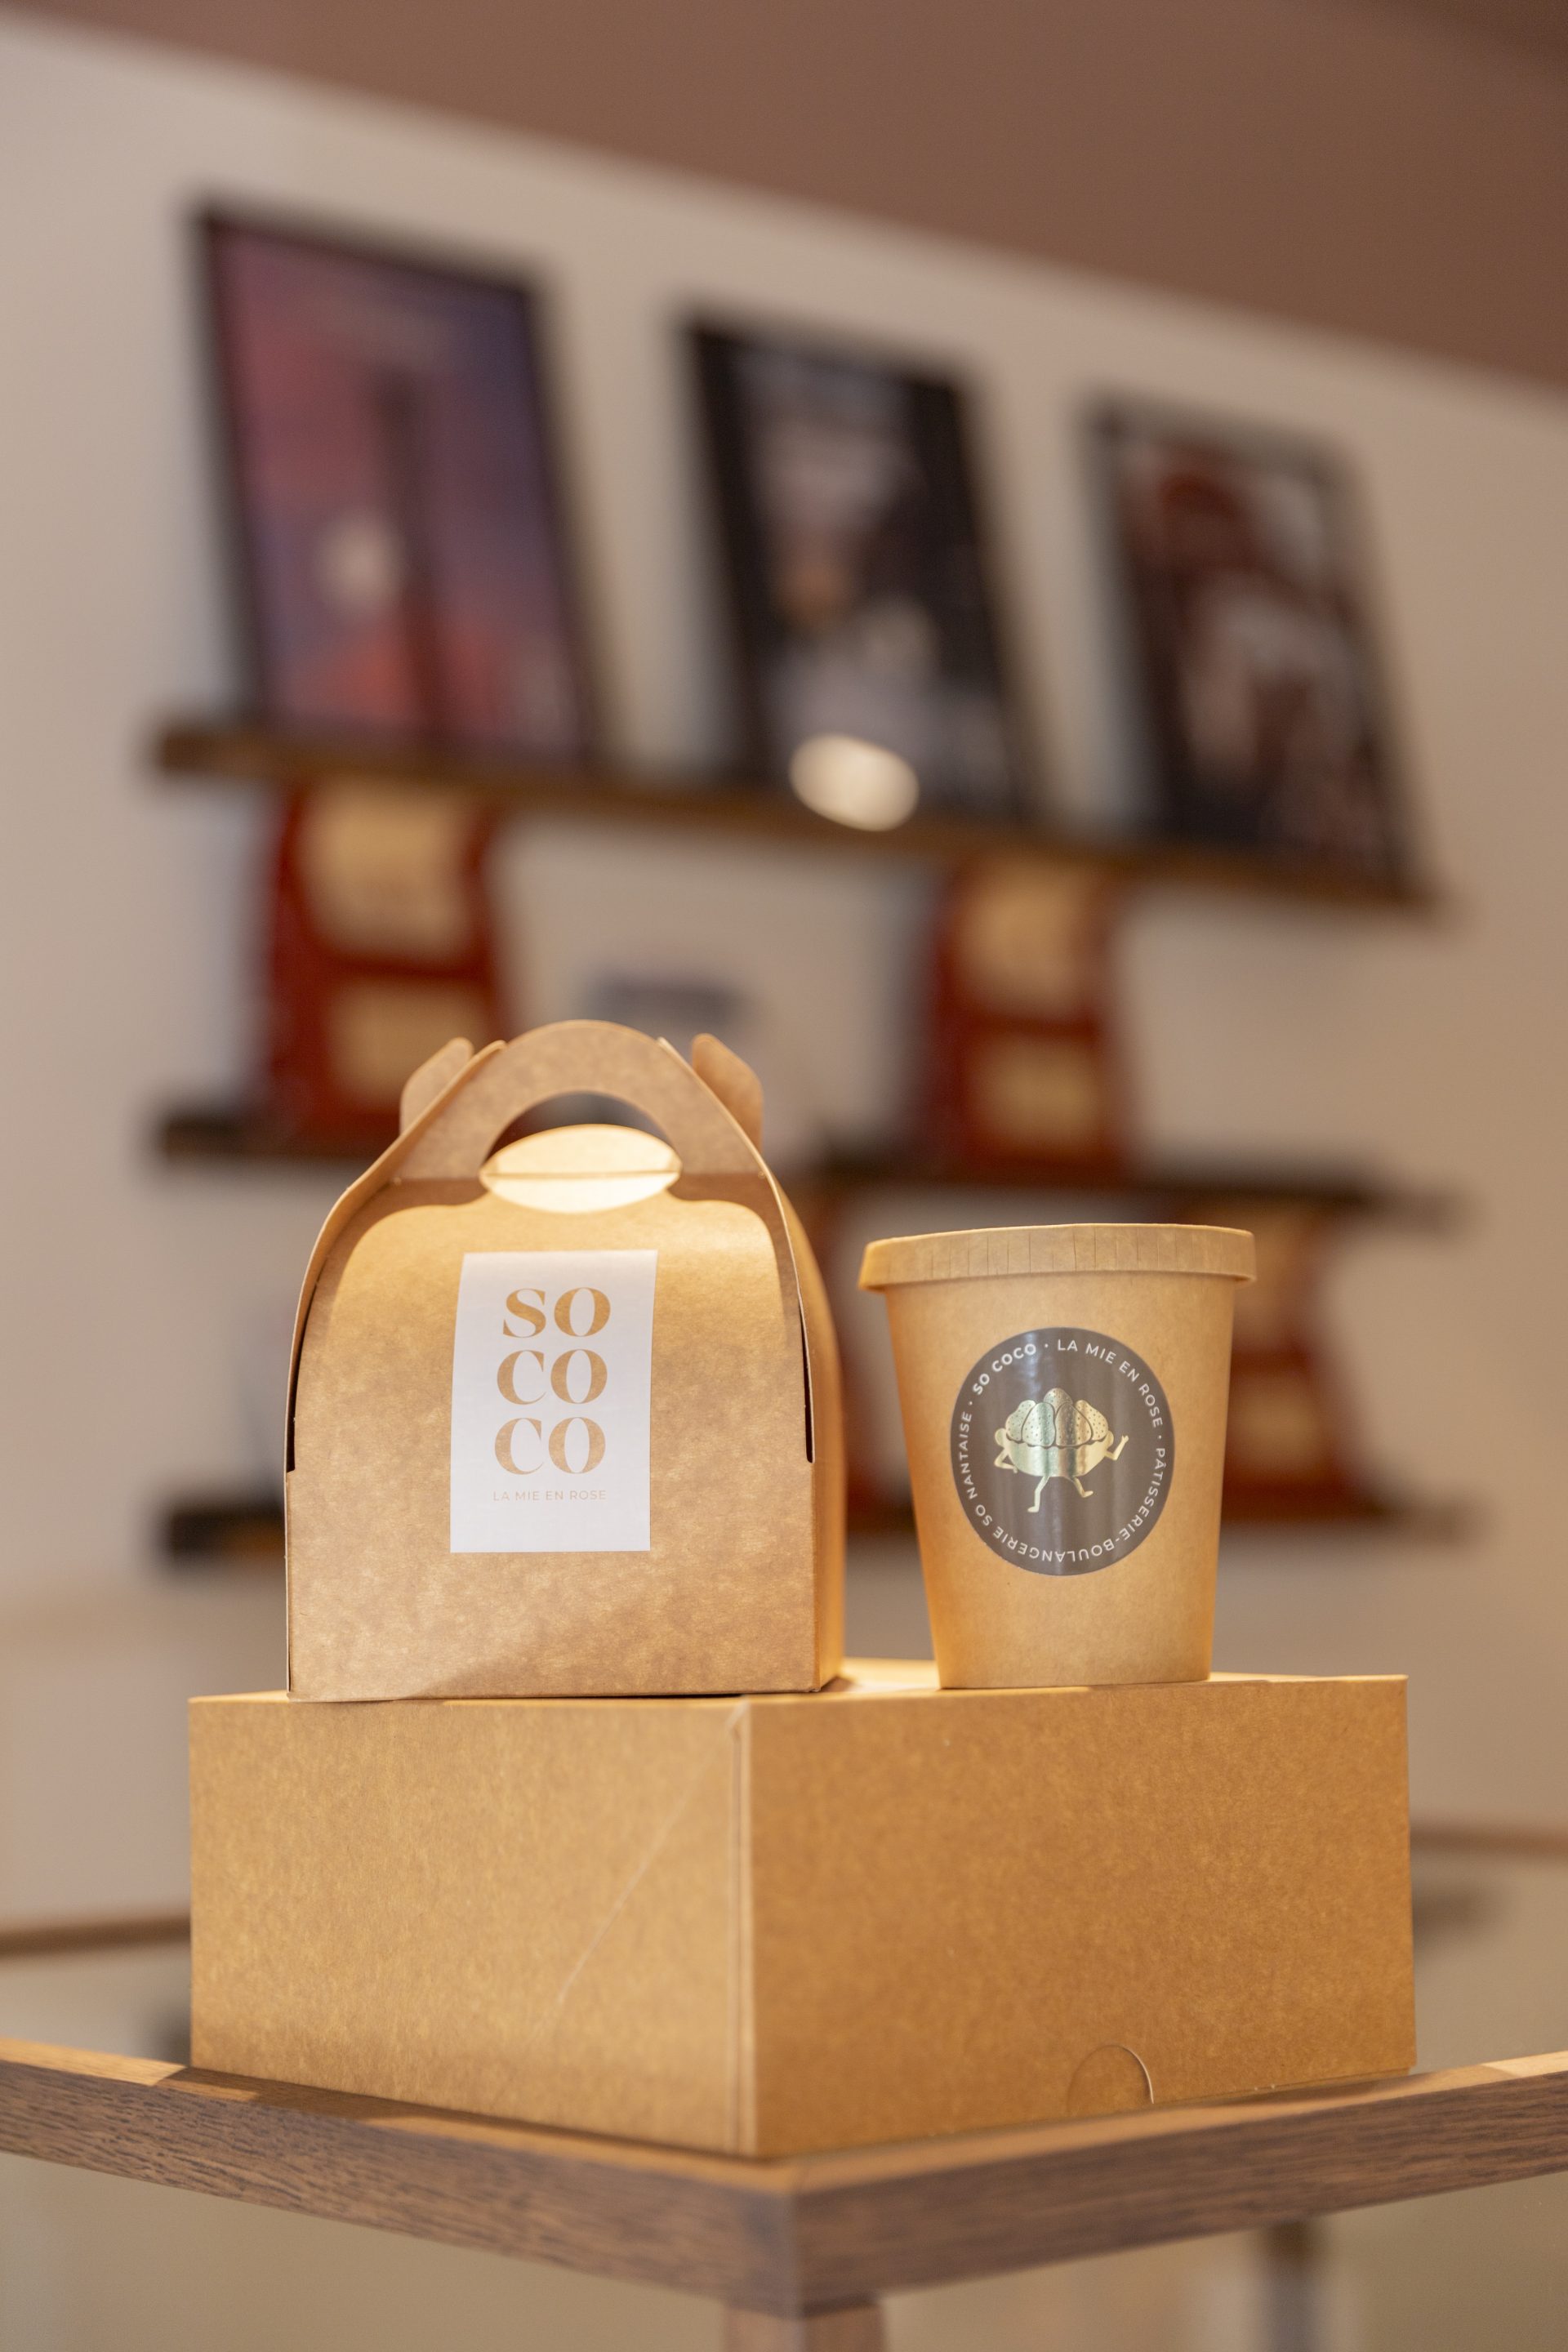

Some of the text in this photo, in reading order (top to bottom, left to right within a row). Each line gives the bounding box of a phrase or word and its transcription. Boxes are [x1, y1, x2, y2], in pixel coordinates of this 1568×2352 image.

[502, 1287, 612, 1338] SO
[991, 1343, 1036, 1373] COCO
[1058, 1339, 1078, 1352] LA
[1085, 1343, 1116, 1364] MIE
[497, 1348, 608, 1405] CO
[973, 1374, 991, 1395] SO
[1119, 1361, 1139, 1383] EN
[1138, 1383, 1163, 1428] ROSE
[494, 1417, 606, 1475] CO
[959, 1411, 978, 1499] NANTAISE
[492, 1490, 607, 1501] LA MIE EN ROSE
[975, 1504, 992, 1526] SO
